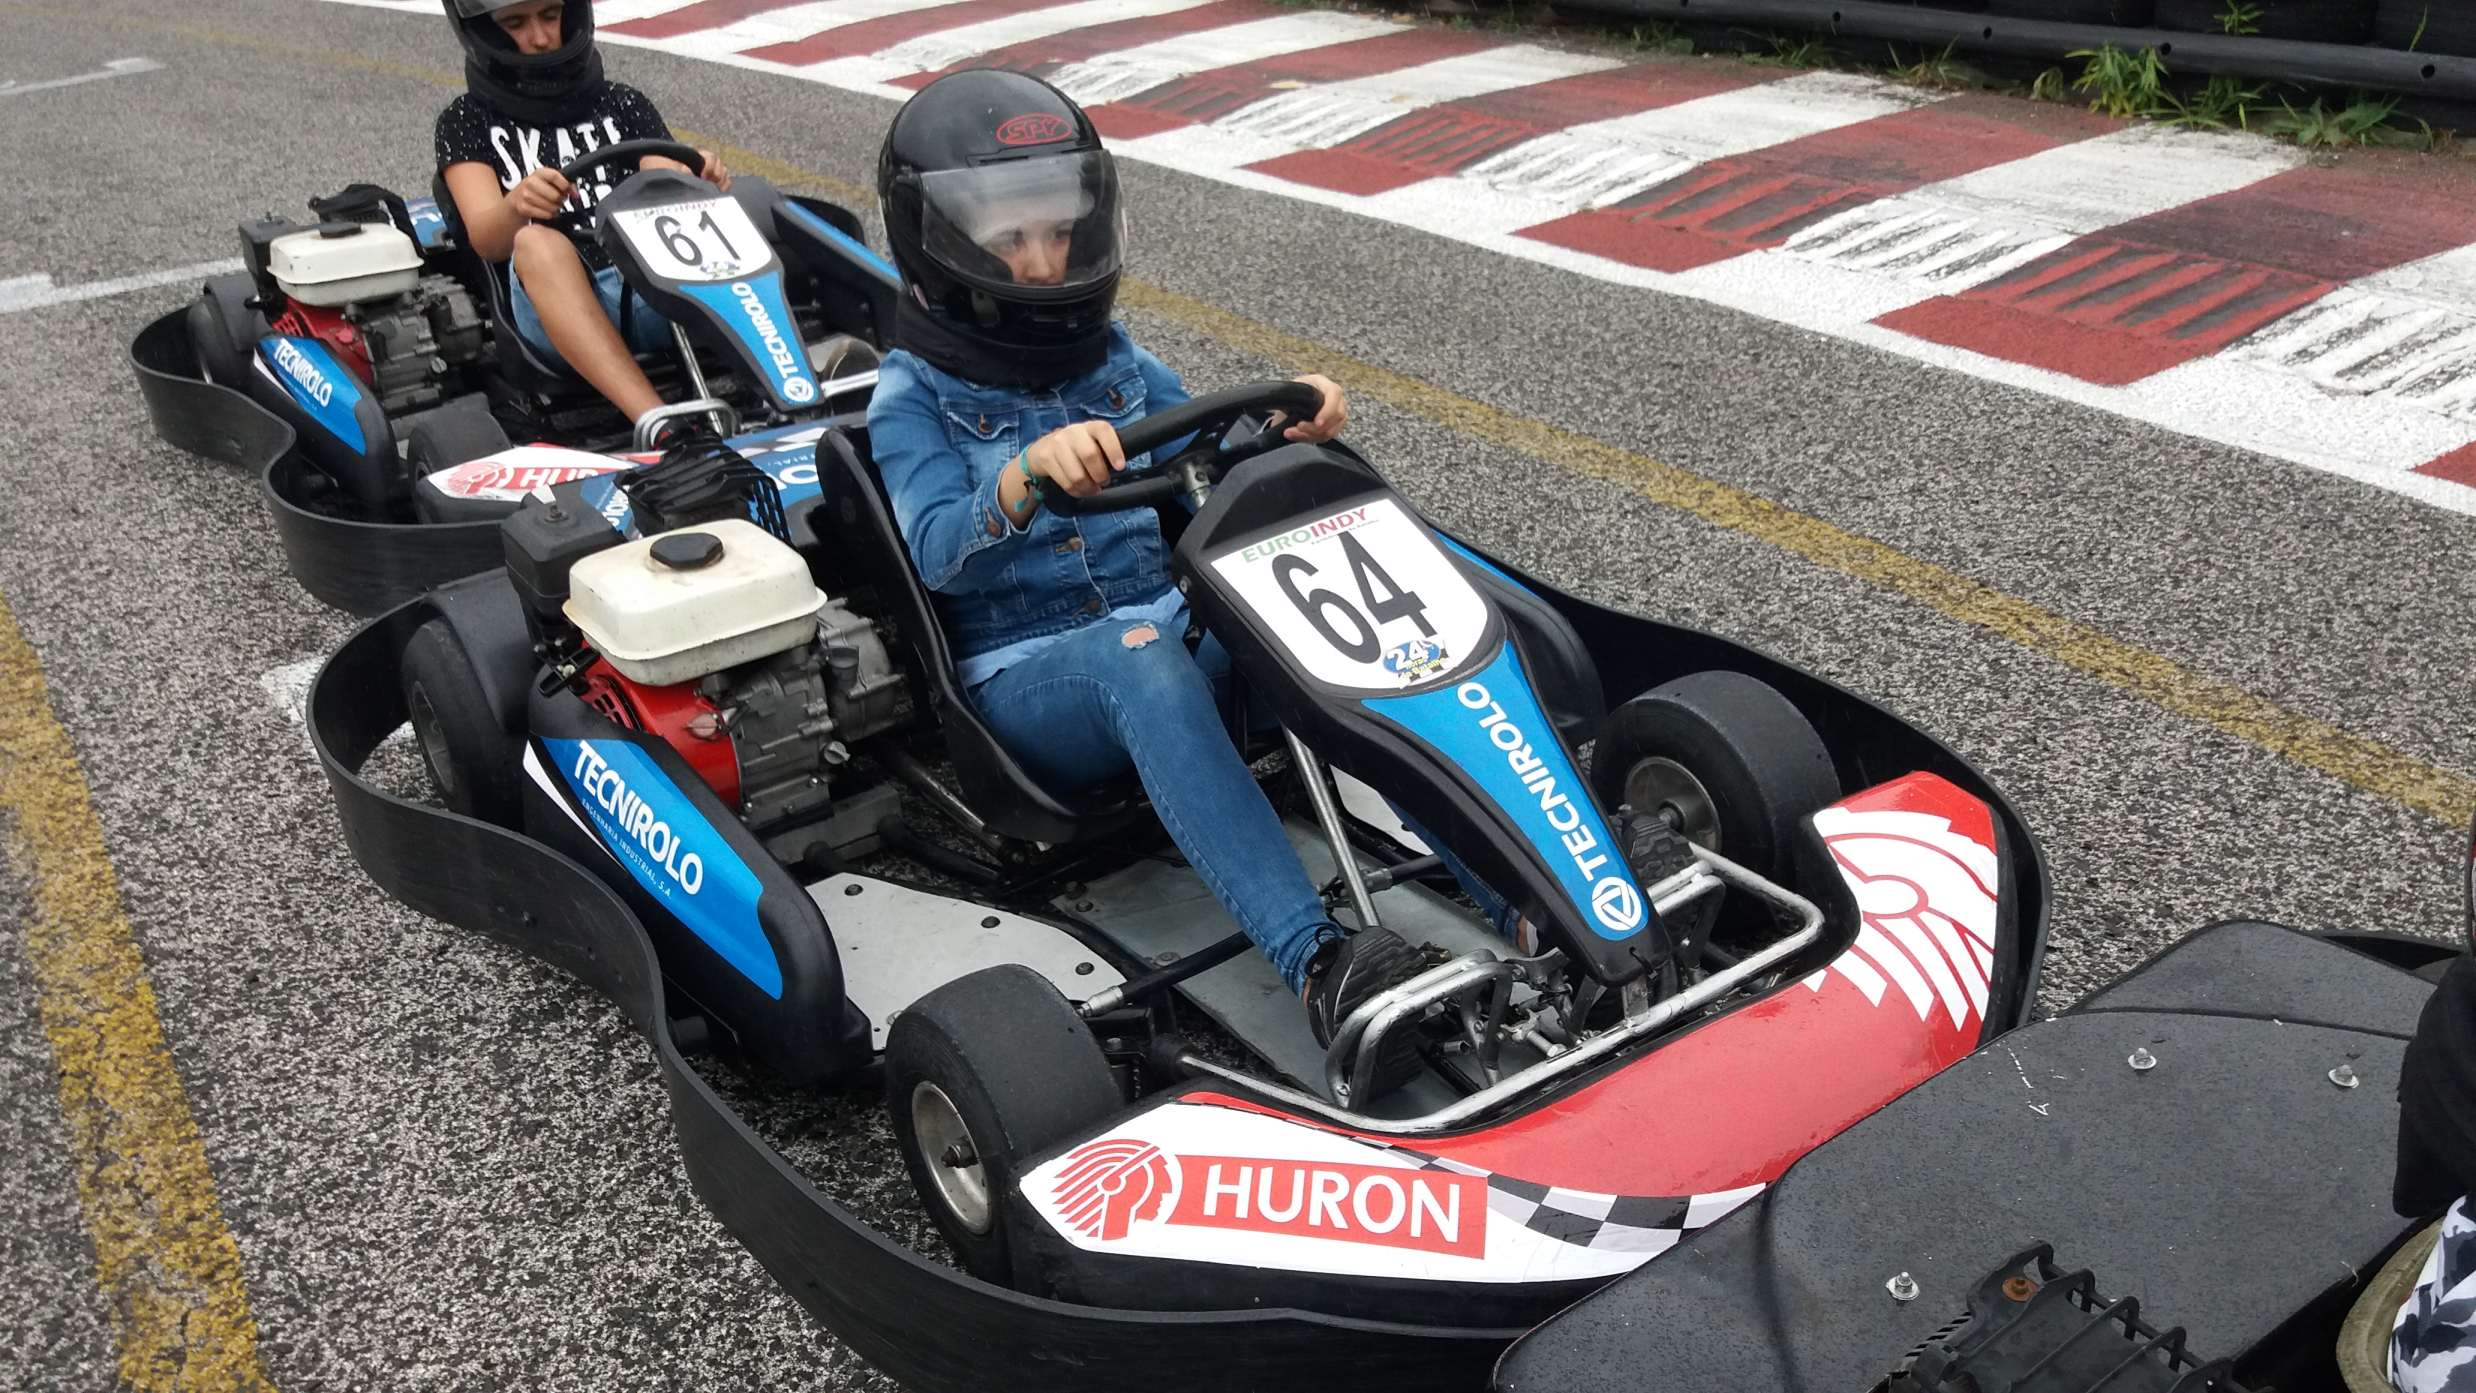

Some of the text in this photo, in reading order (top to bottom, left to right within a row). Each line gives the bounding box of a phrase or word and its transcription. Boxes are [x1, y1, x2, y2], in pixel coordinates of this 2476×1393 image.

[655, 210, 741, 267] 61
[274, 337, 333, 407] TECNIROLO
[732, 282, 799, 378] TECNIROLO
[1241, 508, 1367, 563] EUROINDY
[1271, 531, 1438, 664] 64
[574, 740, 704, 895] TECNIROLO
[1457, 682, 1608, 882] TECNIROLO
[1183, 1163, 1461, 1243] HURON
